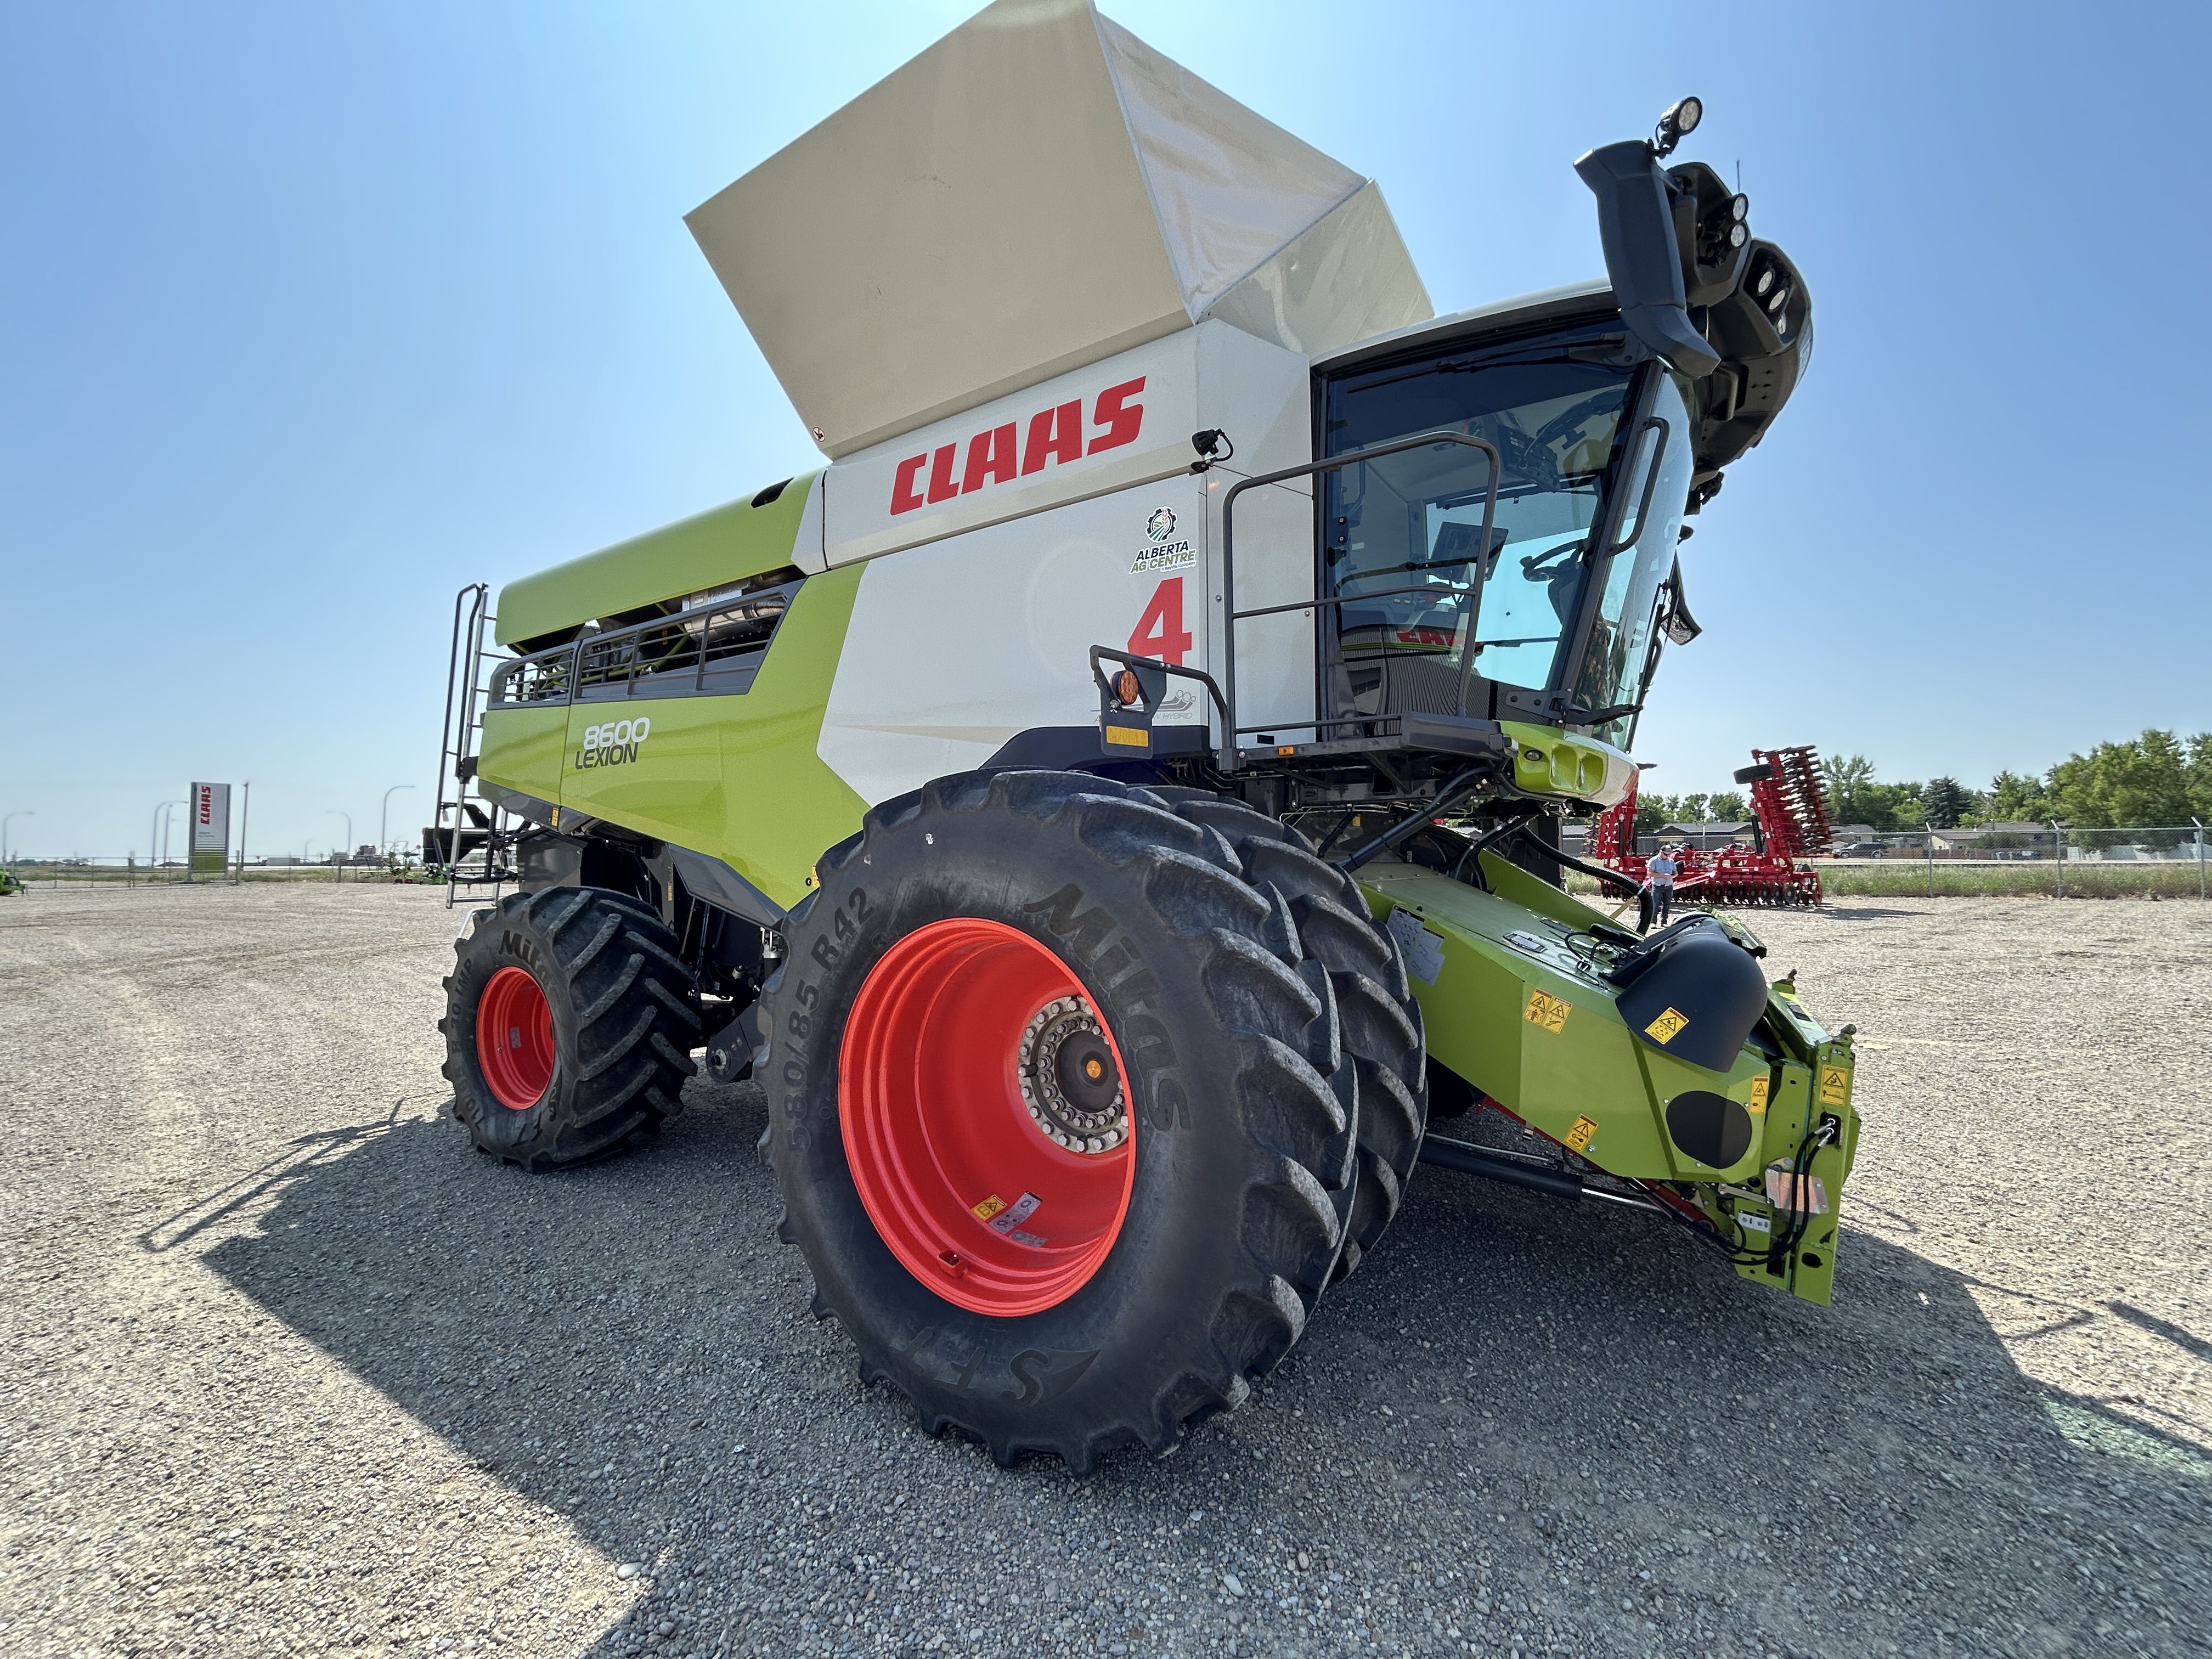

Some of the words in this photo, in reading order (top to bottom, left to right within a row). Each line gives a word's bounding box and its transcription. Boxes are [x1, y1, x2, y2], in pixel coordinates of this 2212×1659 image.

[890, 375, 1147, 516] CLAAS
[1130, 561, 1147, 573] AG
[1149, 550, 1196, 569] CENTRE
[1136, 540, 1189, 562] ALBERTA
[1127, 576, 1192, 667] 4
[583, 716, 650, 750] 8600
[575, 742, 639, 770] LEXION
[200, 785, 211, 825] CLAAS
[454, 957, 472, 997] IMP
[783, 978, 821, 1153] 580/85
[810, 887, 876, 973] R42
[1023, 883, 1190, 1132] Mitas
